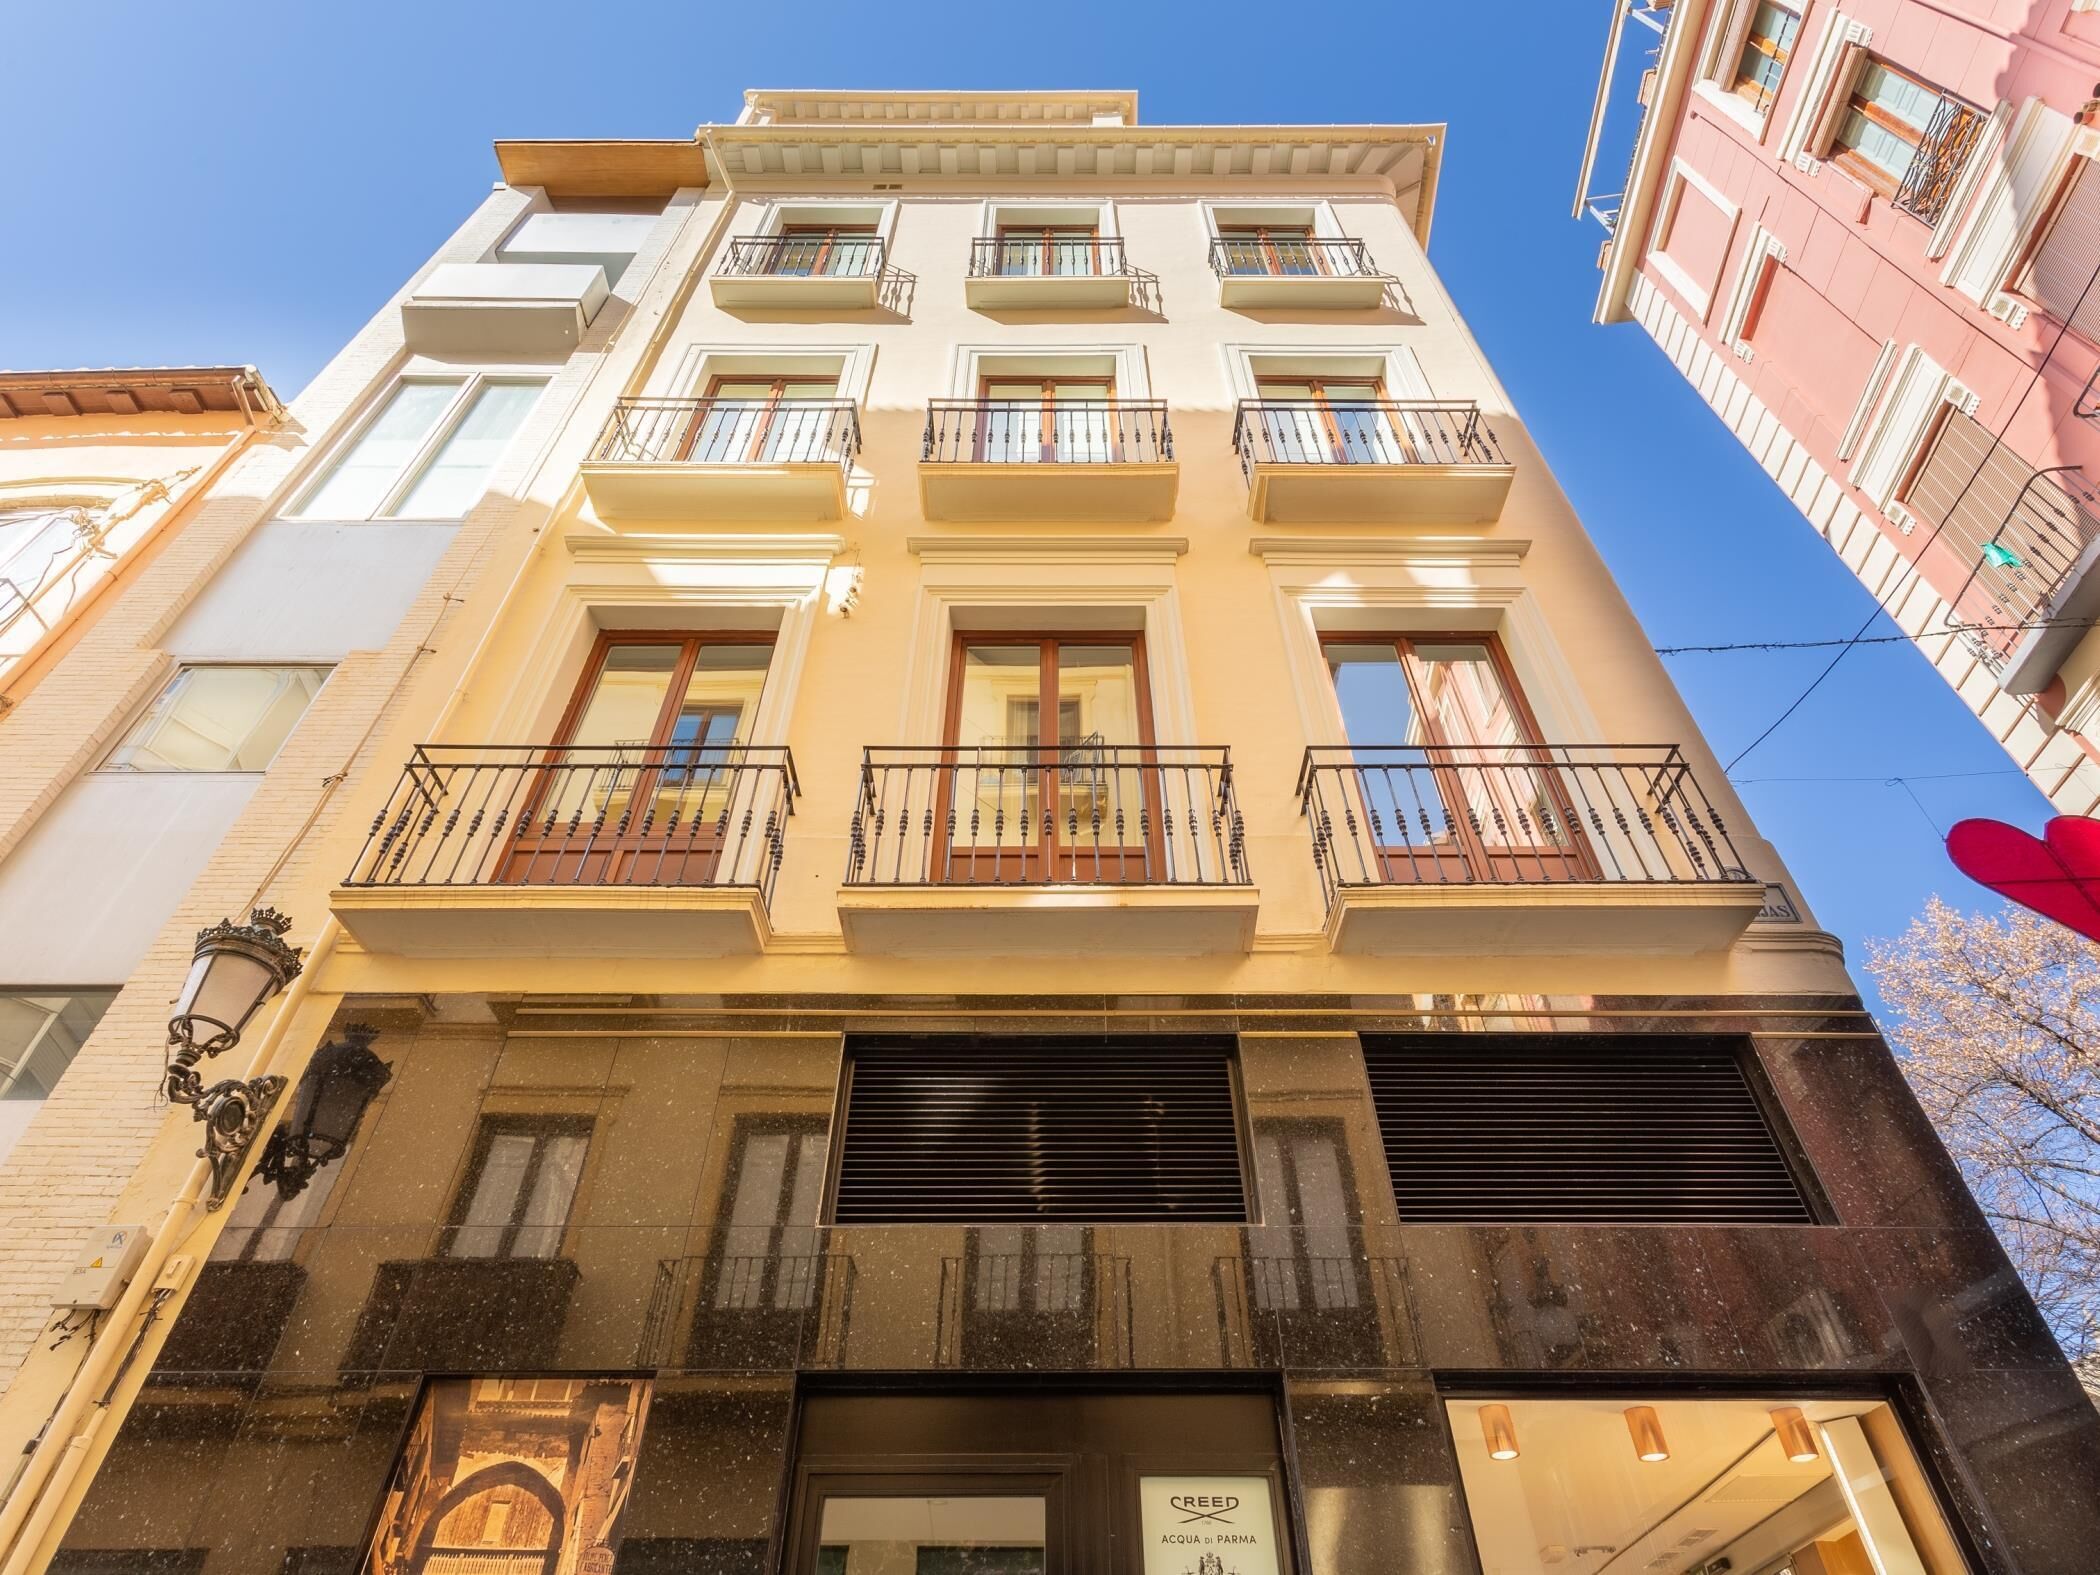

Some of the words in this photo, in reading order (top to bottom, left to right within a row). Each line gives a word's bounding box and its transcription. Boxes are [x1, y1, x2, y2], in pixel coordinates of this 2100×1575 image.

[1759, 905, 1791, 917] JAS
[1161, 1534, 1201, 1545] ACQUA
[1217, 1534, 1257, 1544] PARMA
